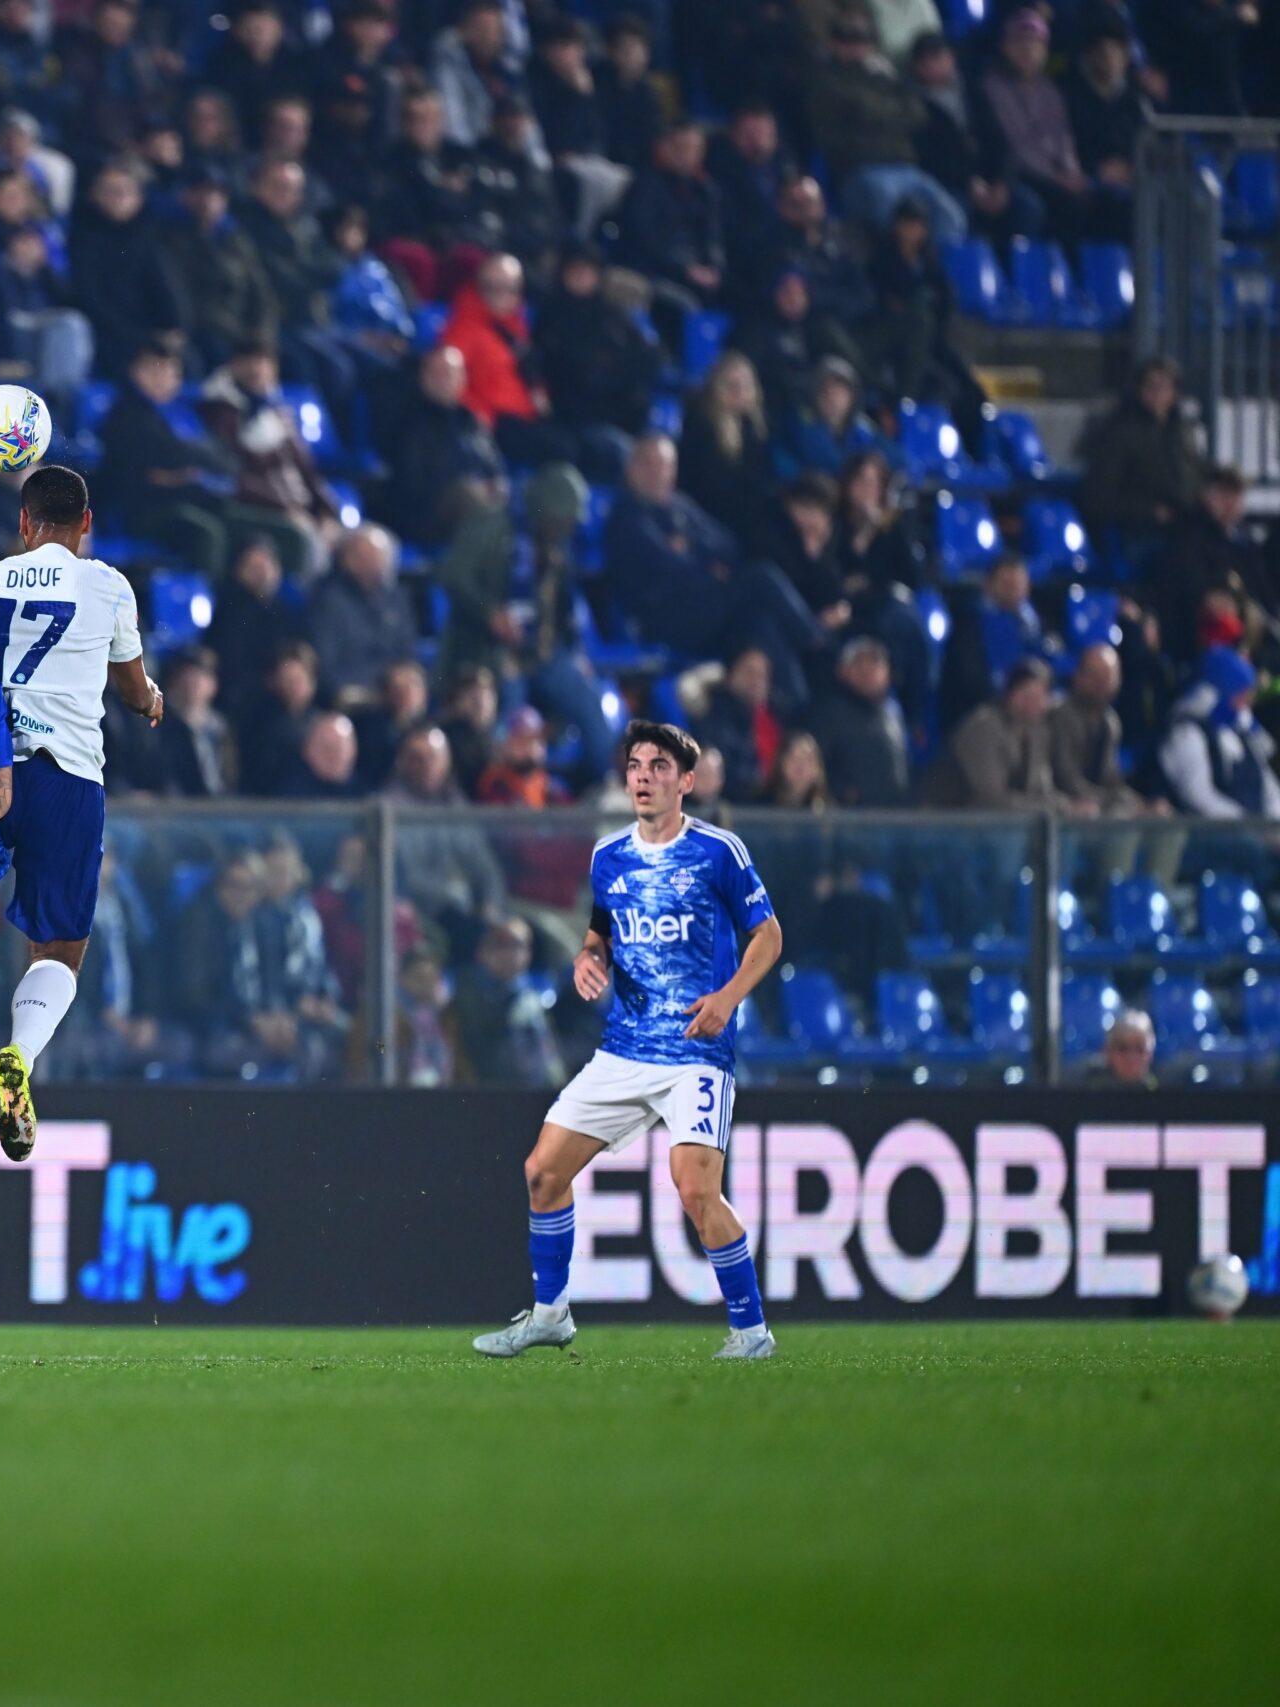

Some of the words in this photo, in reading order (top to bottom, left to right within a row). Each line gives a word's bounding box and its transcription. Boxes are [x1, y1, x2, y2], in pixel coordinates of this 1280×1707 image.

[6, 567, 62, 588] DIOUF
[611, 908, 694, 944] Uber
[697, 1076, 714, 1112] 3
[568, 1119, 1265, 1304] EUROBET
